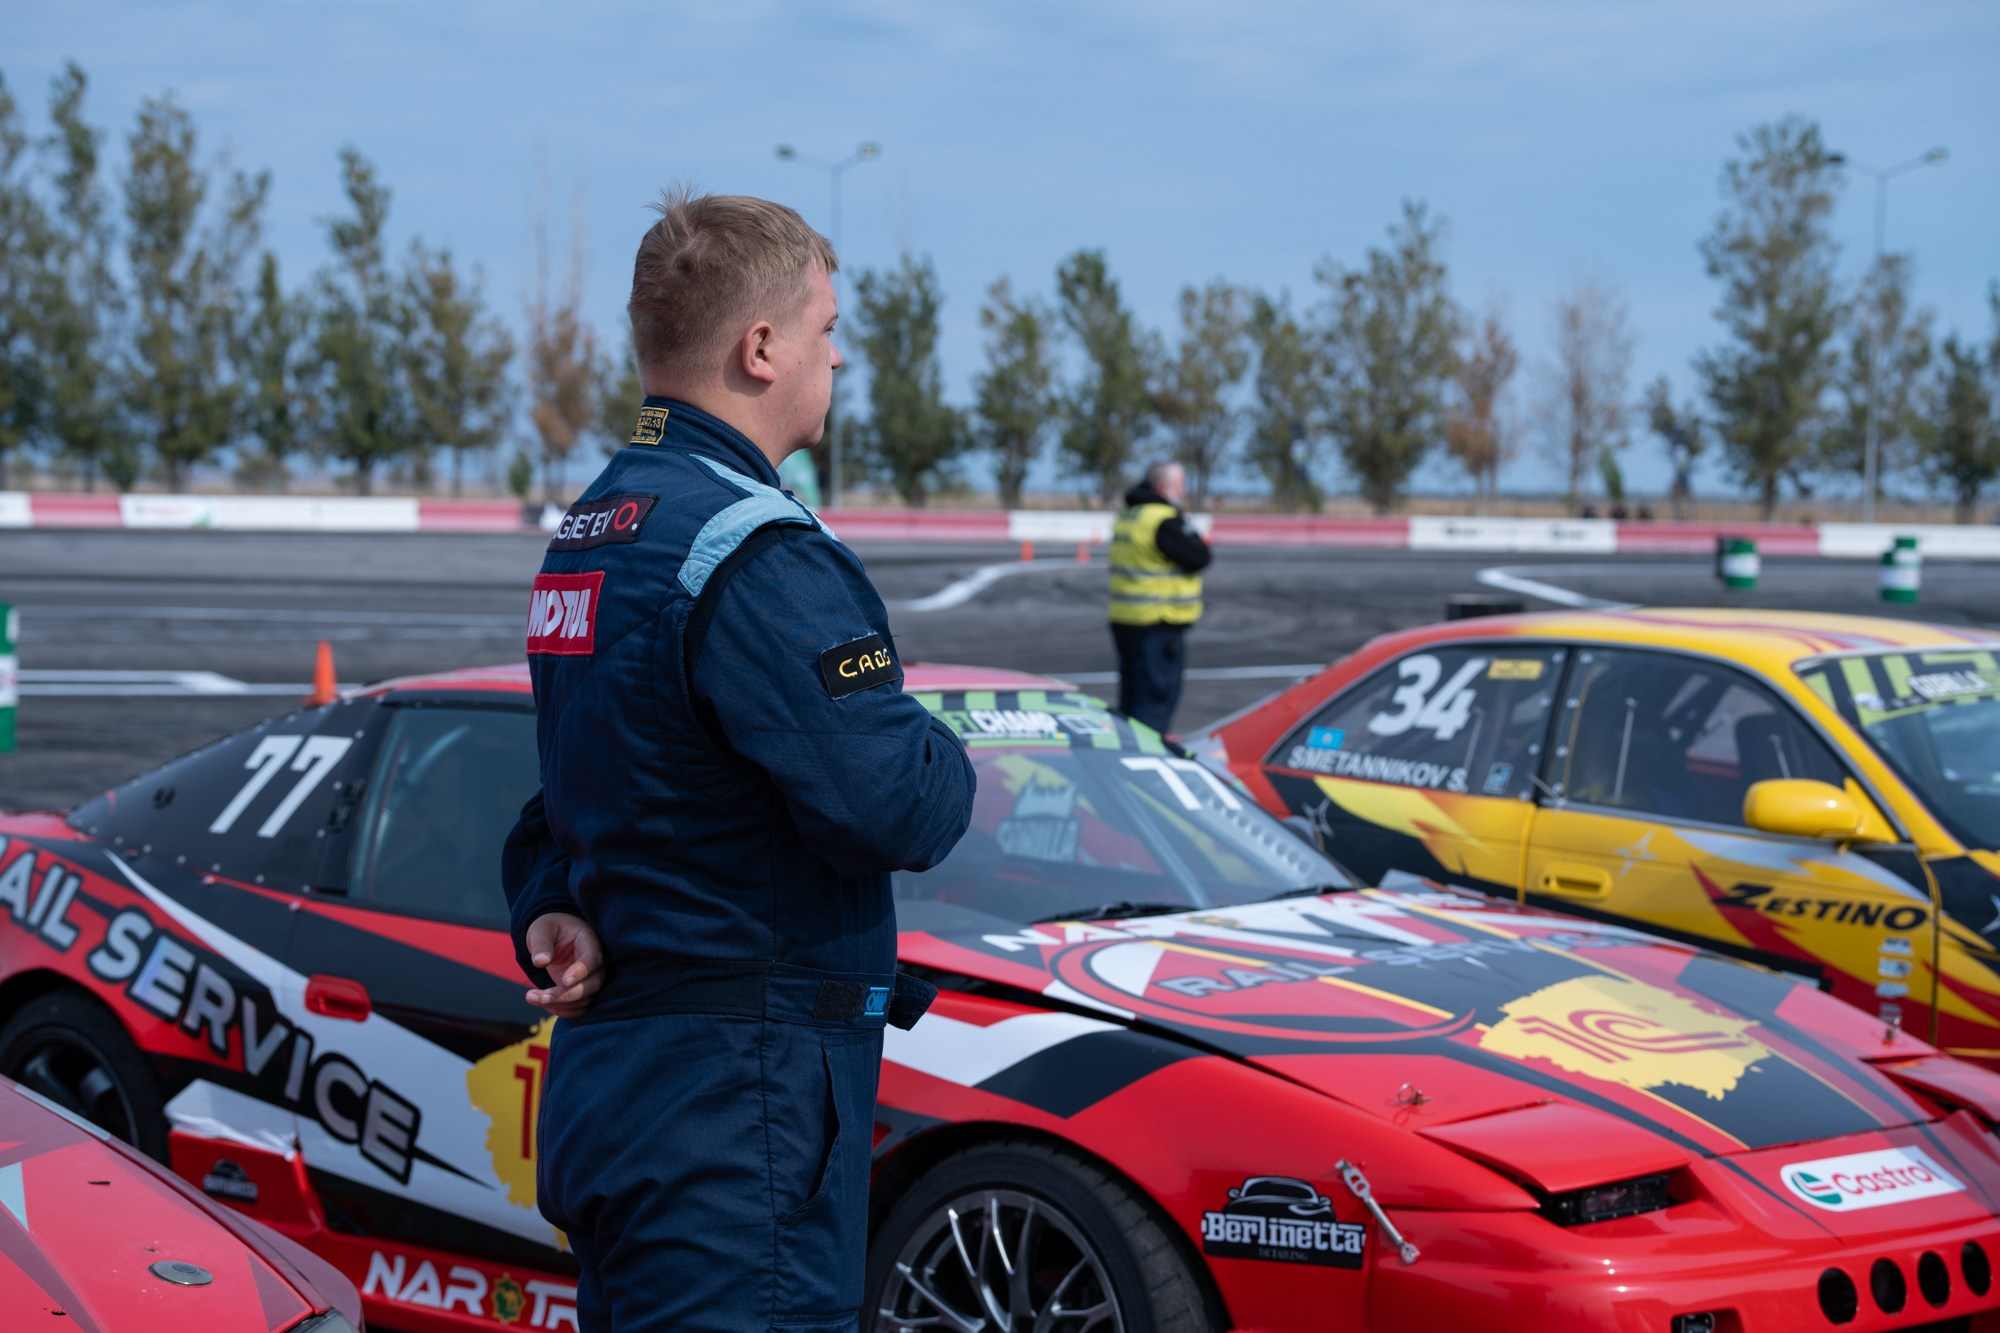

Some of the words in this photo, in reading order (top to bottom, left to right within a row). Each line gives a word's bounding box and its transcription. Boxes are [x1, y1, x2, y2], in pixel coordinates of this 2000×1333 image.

[527, 589, 591, 639] MOTUL
[1367, 655, 1488, 740] 34
[209, 735, 354, 837] 77
[1119, 757, 1242, 810] 77
[1288, 745, 1448, 788] SMETANNIKOV
[1713, 882, 1928, 930] ZESTINO
[0, 834, 79, 949] AIL
[89, 911, 416, 1182] SERVICE
[1831, 1160, 1941, 1195] Castrol
[1201, 1212, 1366, 1254] Berlinetta
[362, 1250, 488, 1316] NAR
